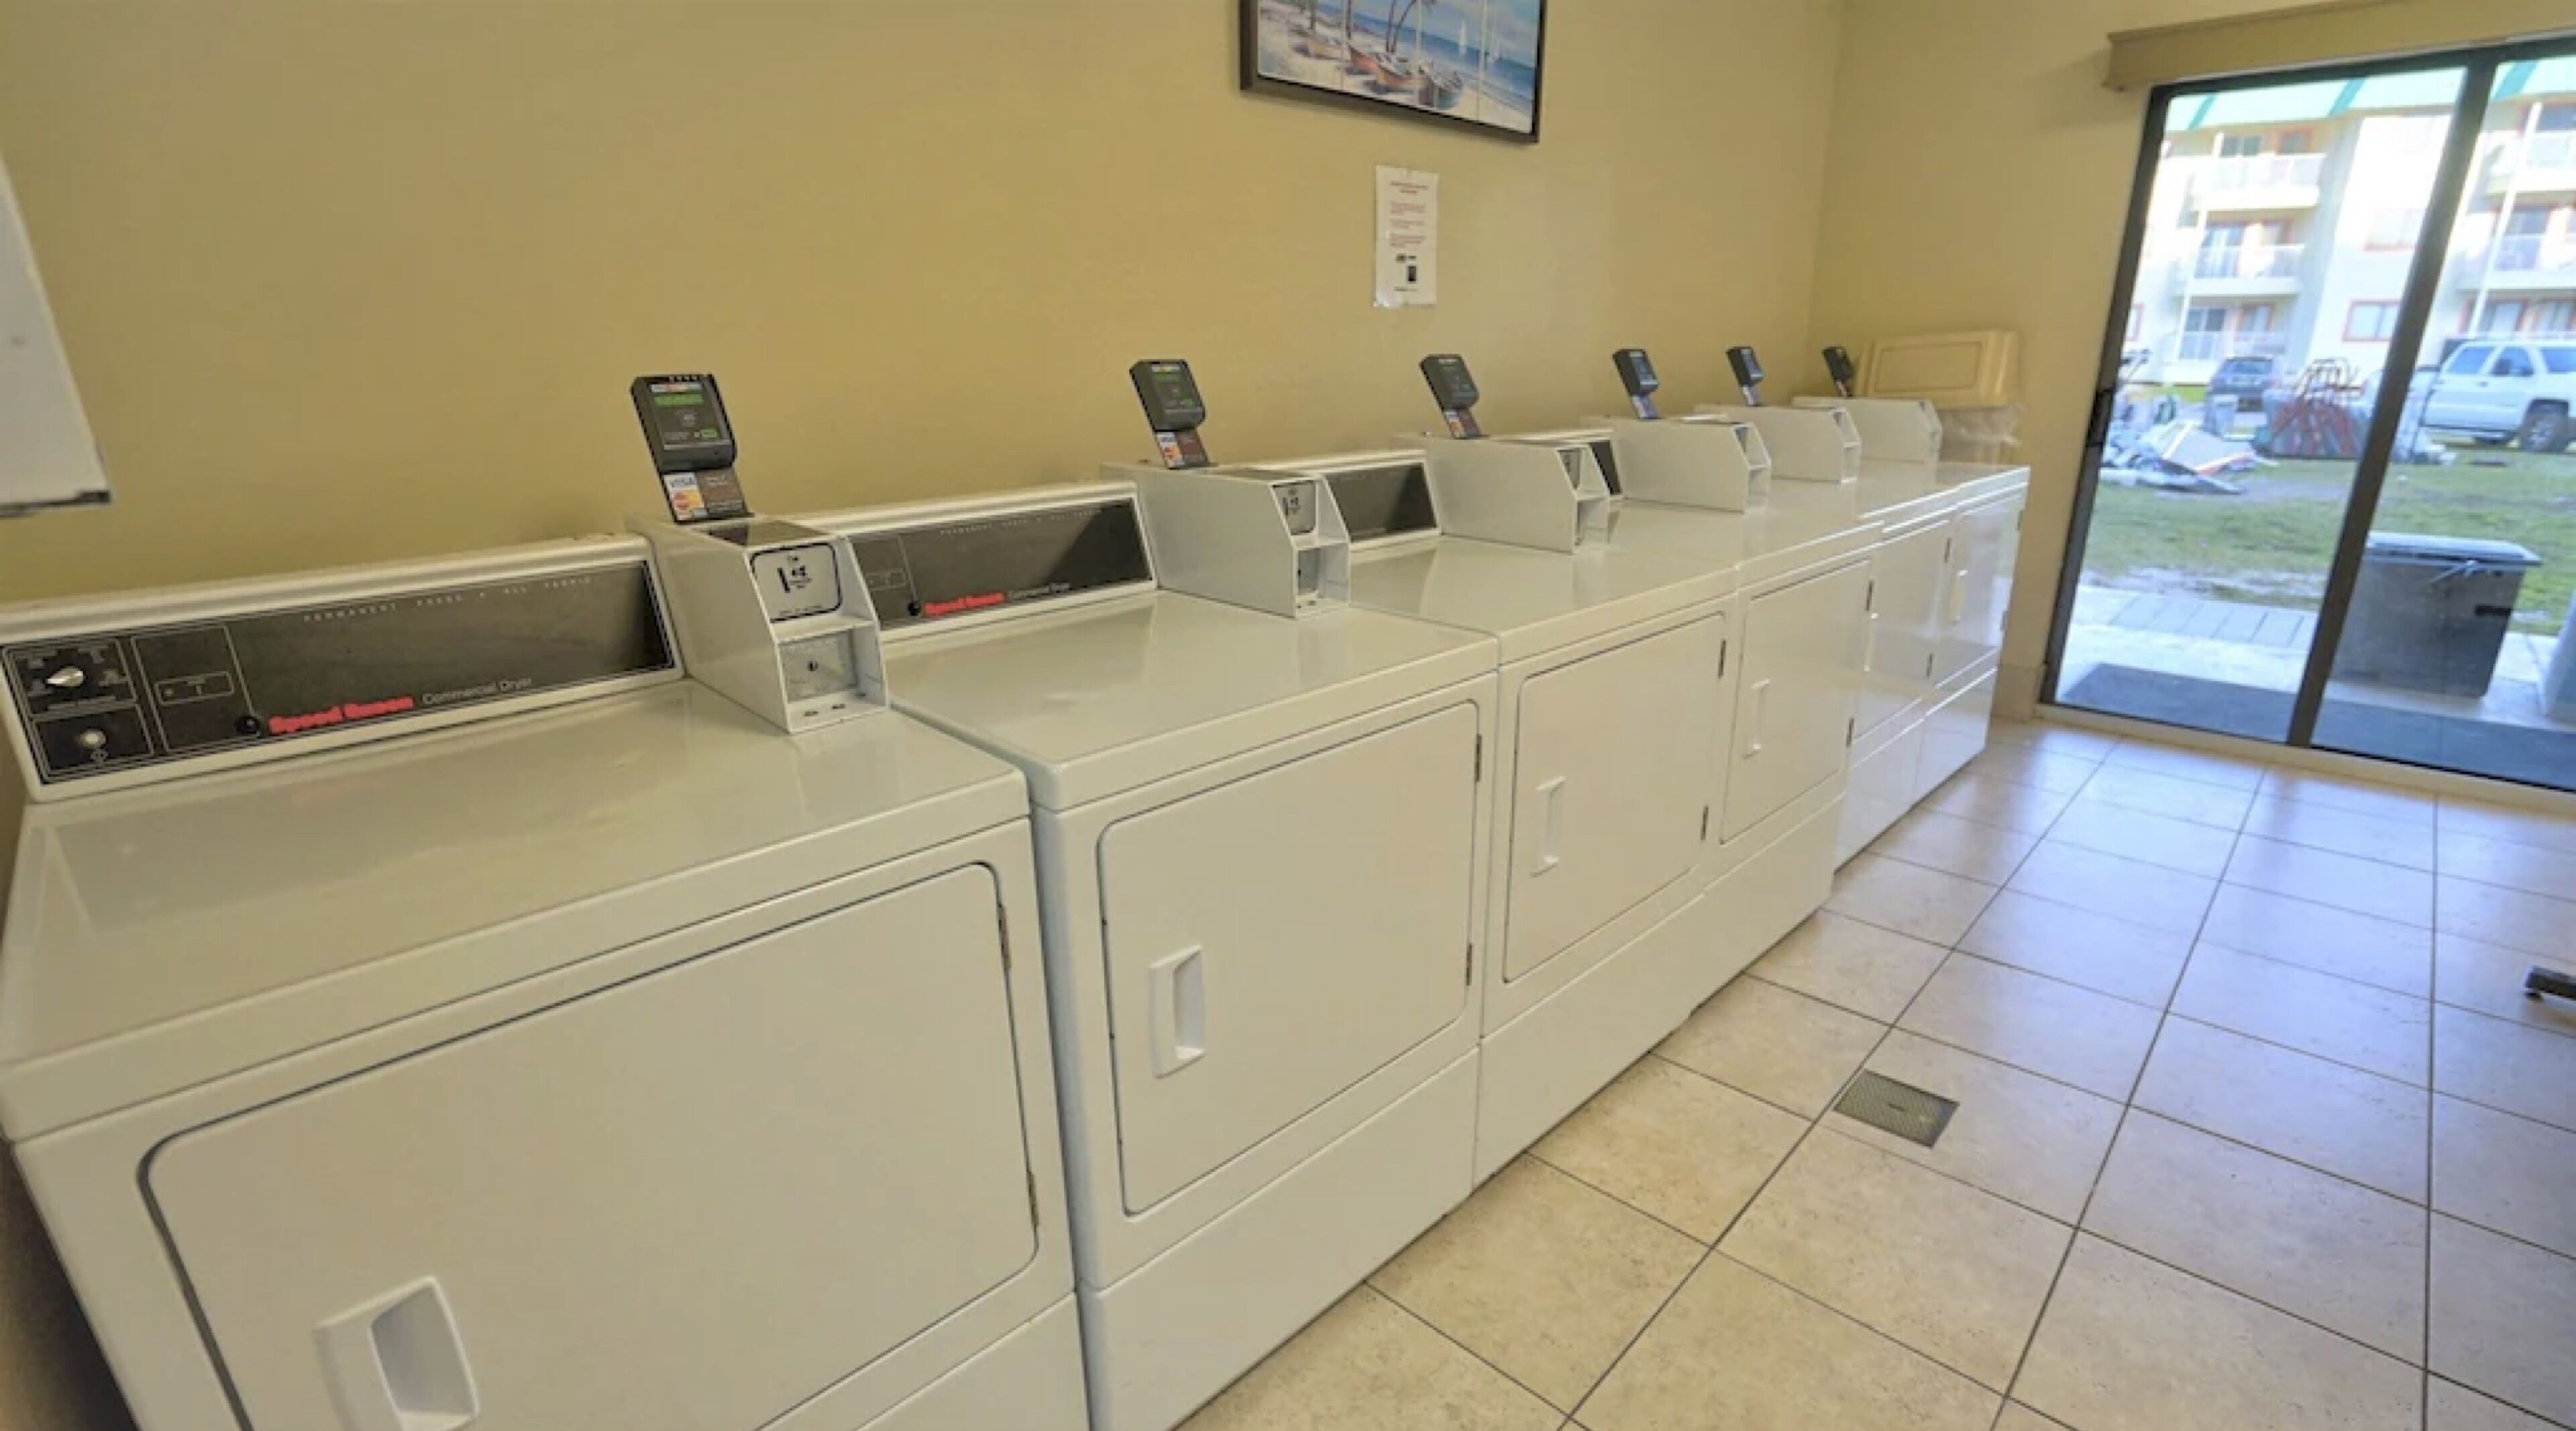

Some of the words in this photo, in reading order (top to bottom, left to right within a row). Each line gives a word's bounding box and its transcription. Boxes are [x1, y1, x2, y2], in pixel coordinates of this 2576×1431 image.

[422, 682, 496, 704] Commercial
[499, 678, 533, 693] Dryer
[268, 706, 343, 733] Speed
[343, 696, 414, 718] Queen
